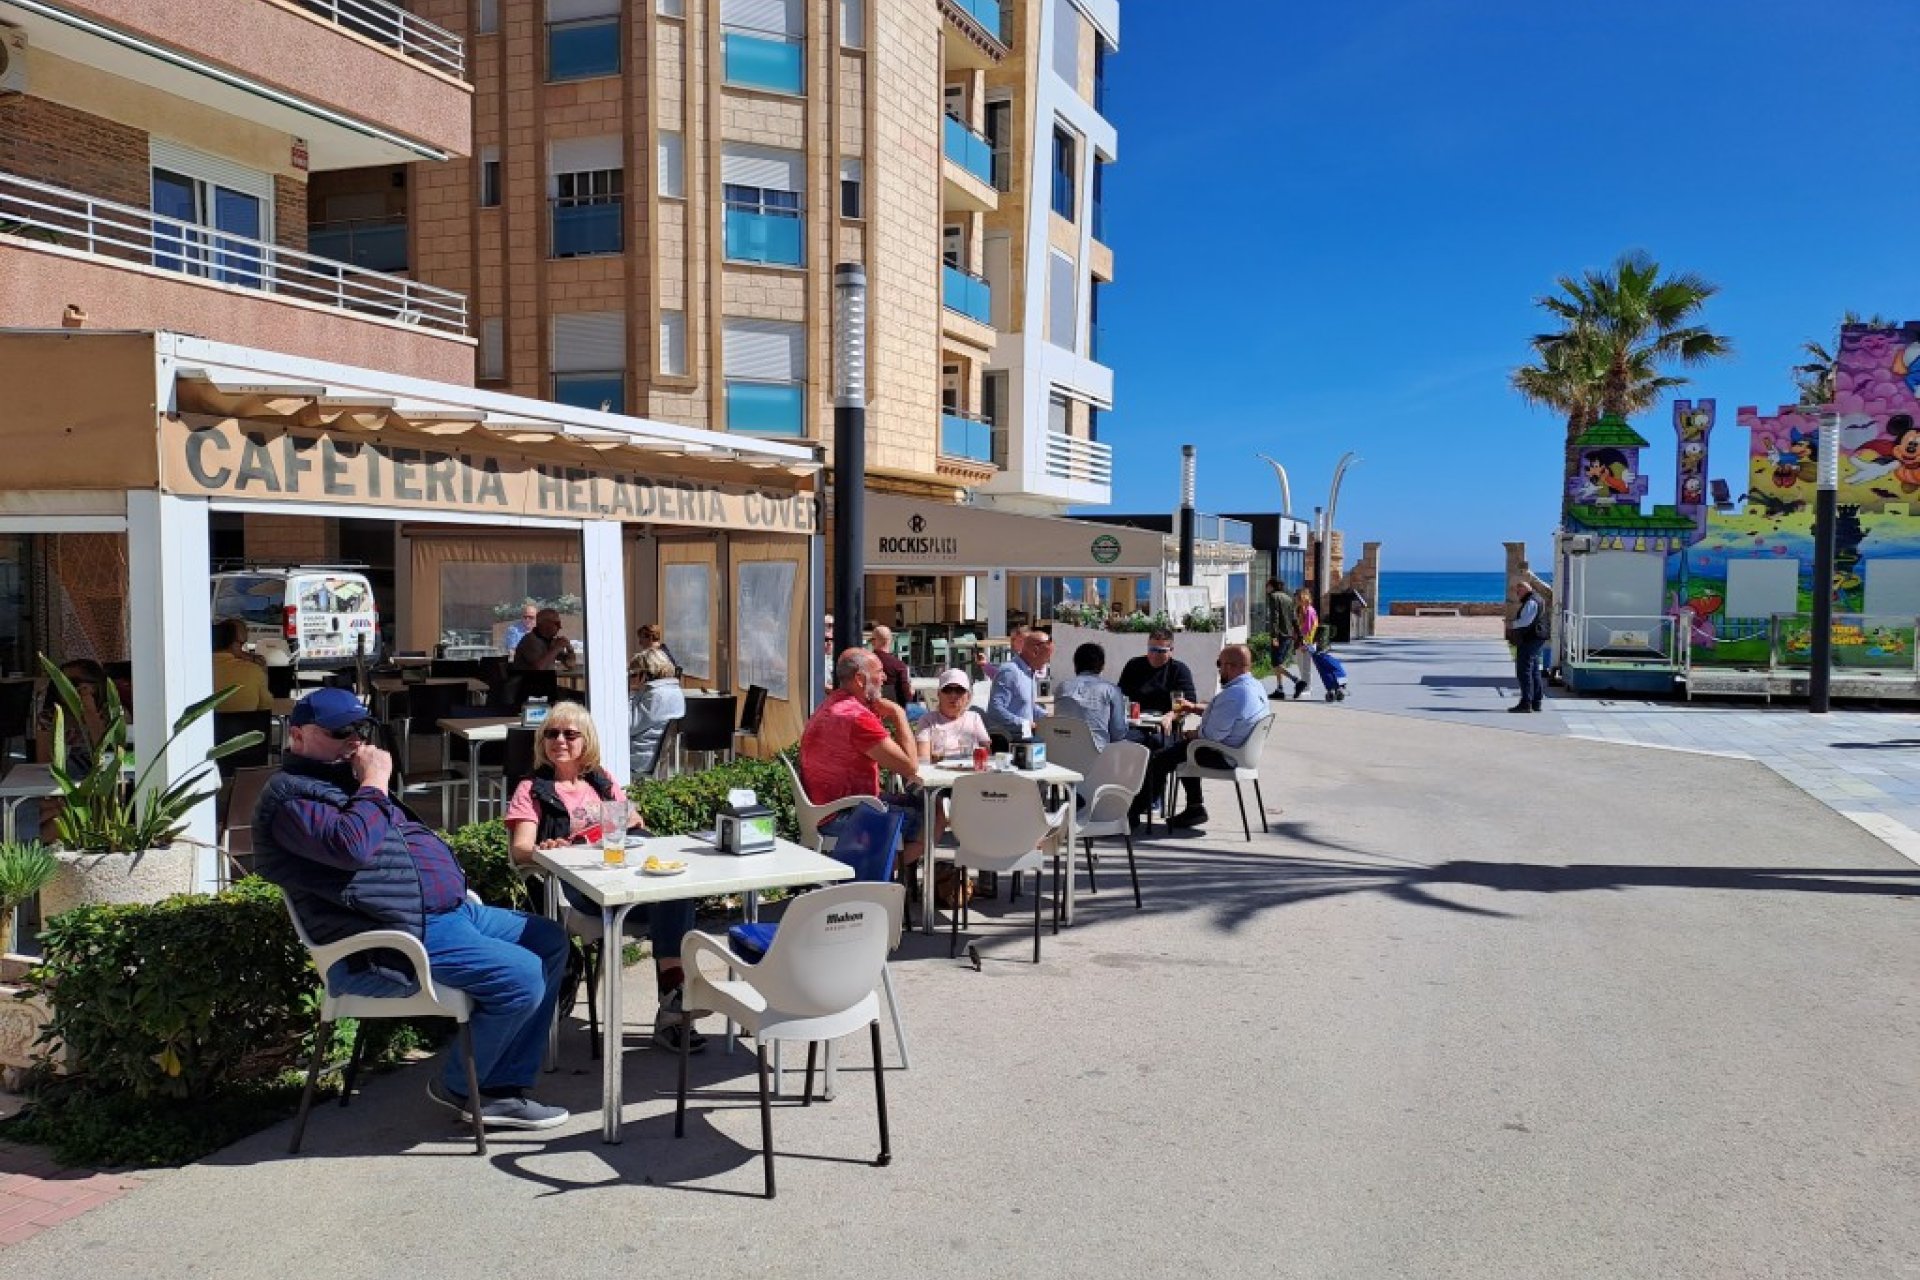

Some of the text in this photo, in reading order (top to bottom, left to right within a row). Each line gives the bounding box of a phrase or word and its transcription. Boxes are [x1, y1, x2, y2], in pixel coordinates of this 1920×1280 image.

[185, 426, 820, 530] CAFETERIA HELADERIA COVER
